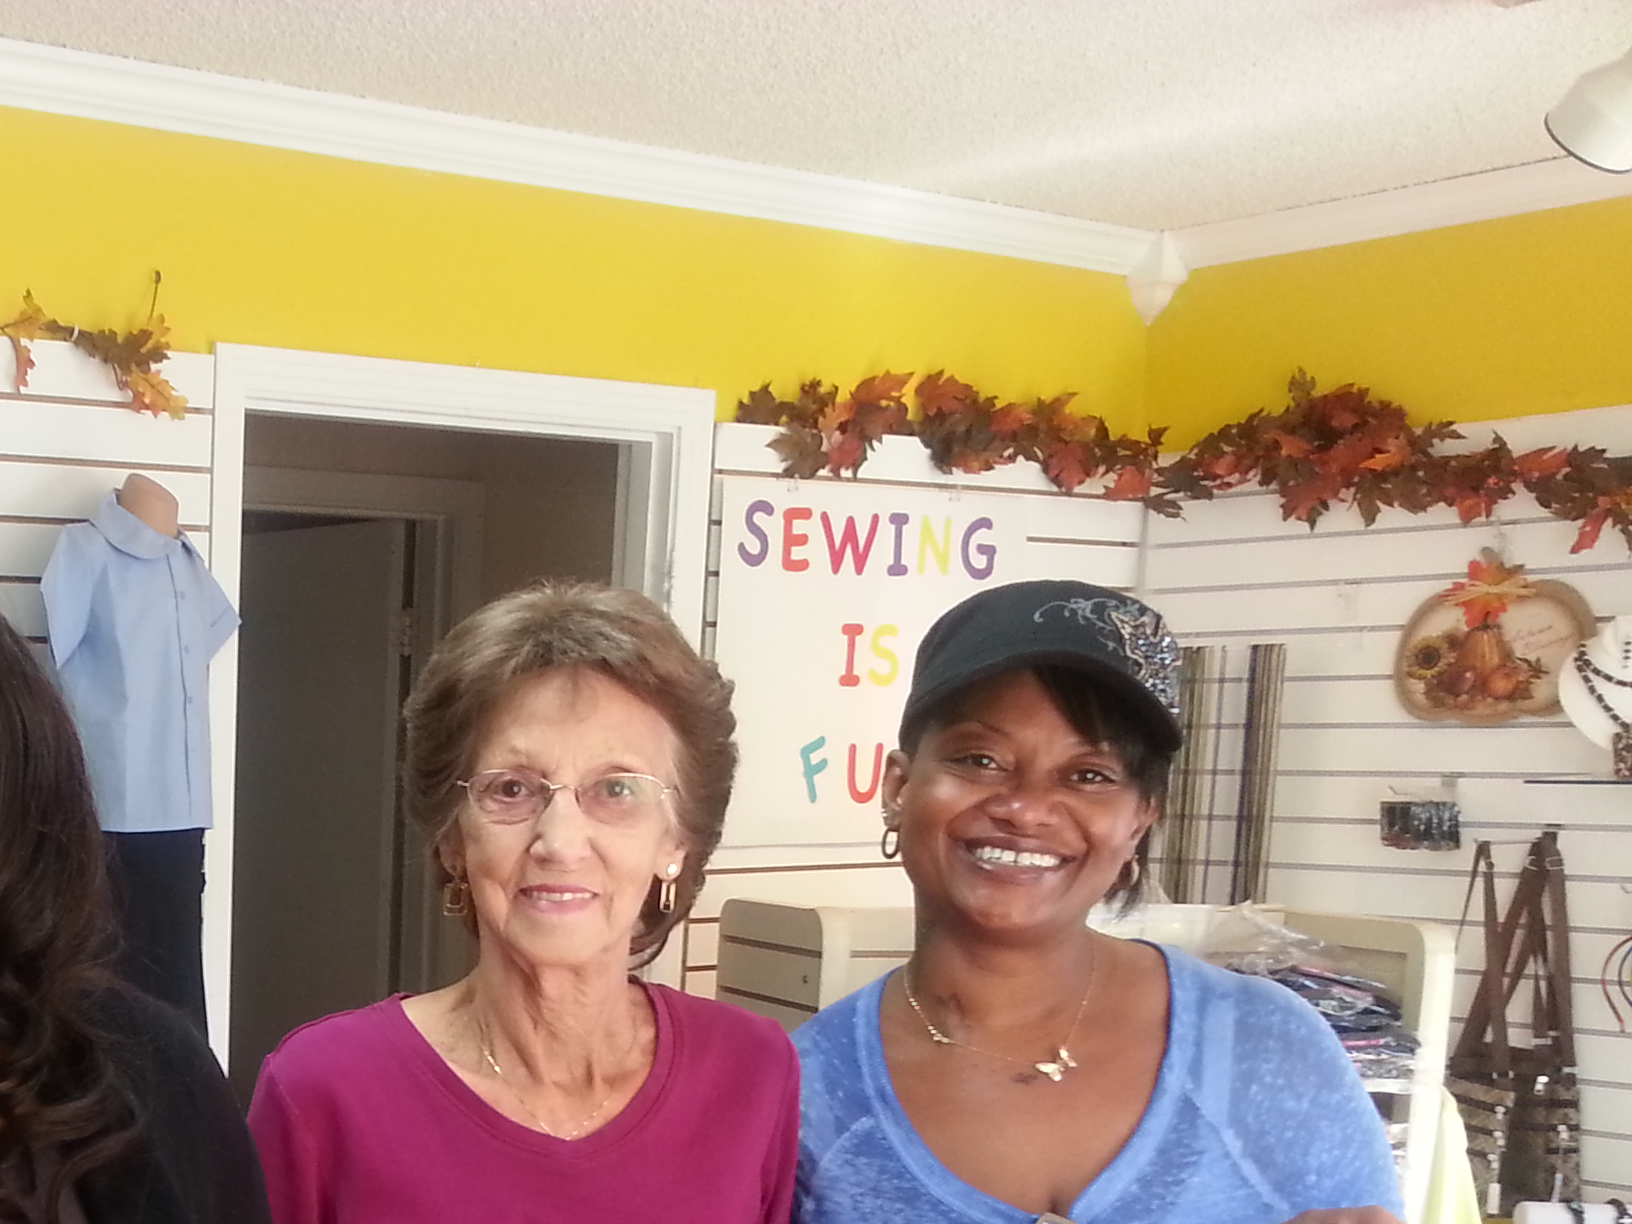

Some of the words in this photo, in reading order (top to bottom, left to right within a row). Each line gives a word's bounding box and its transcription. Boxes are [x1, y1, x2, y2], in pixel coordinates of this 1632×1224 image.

[737, 499, 998, 580] SEWING
[839, 622, 900, 687] IS
[800, 735, 884, 804] FU
